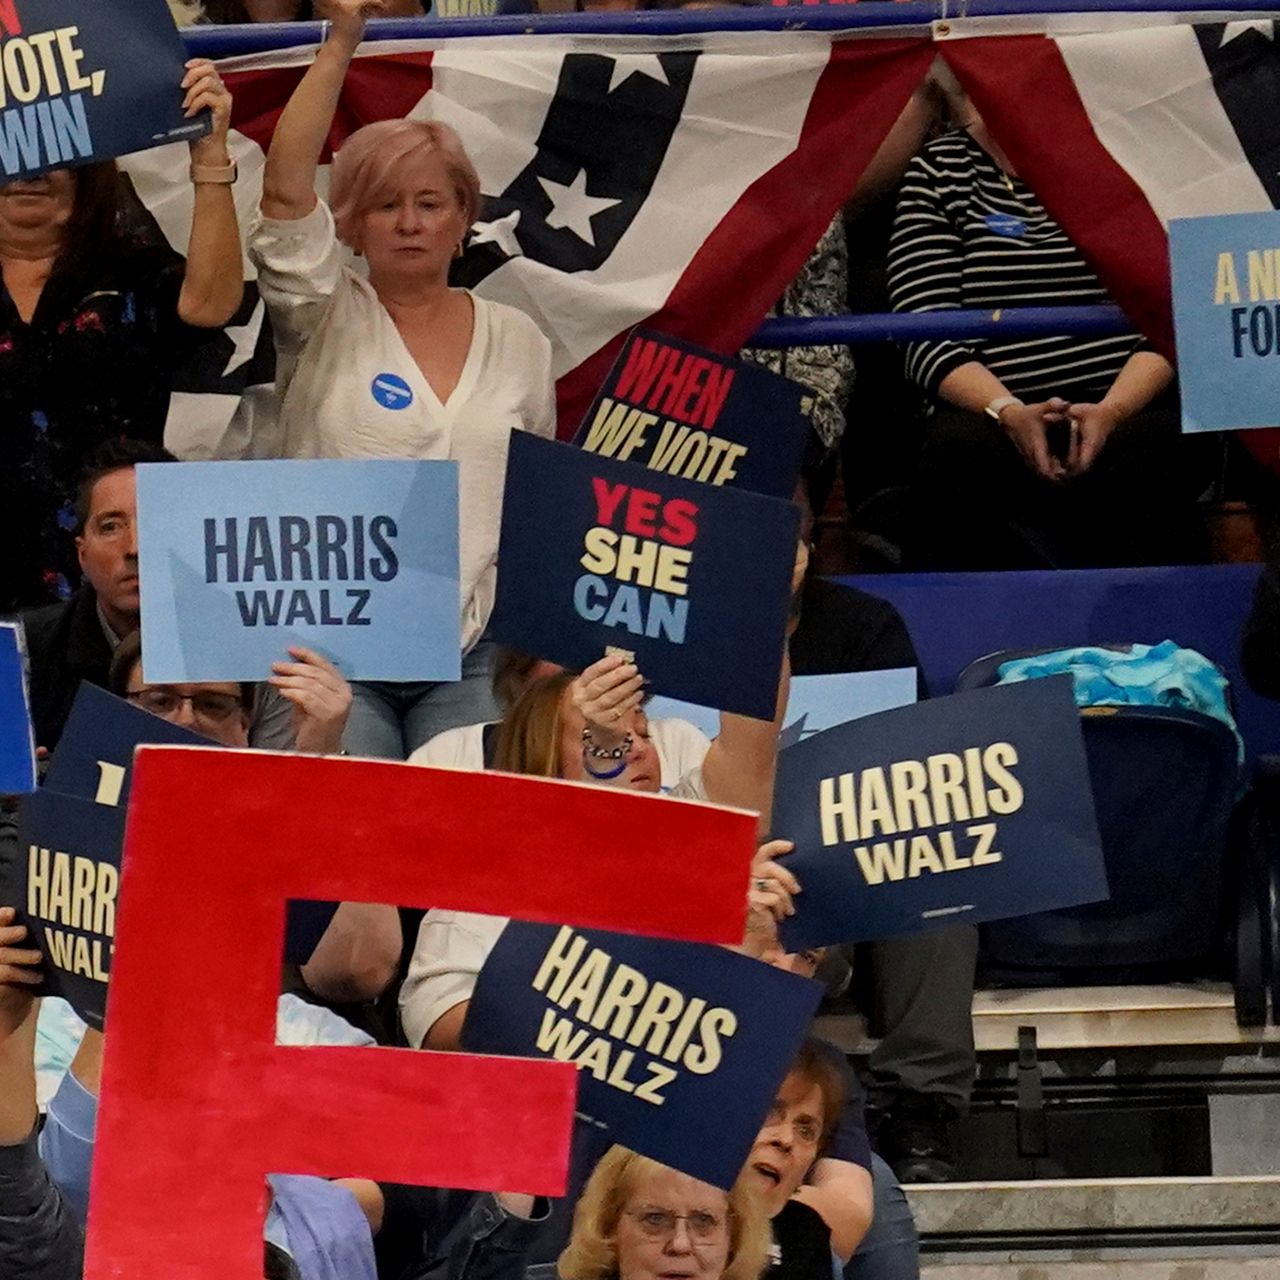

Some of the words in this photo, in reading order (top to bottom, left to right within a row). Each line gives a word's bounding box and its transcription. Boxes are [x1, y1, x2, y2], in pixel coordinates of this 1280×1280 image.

[1214, 252, 1241, 305] A
[613, 336, 735, 430] WHEN
[583, 397, 653, 463] WE
[591, 478, 699, 545] YES
[203, 514, 399, 583] HARRIS
[580, 527, 693, 595] SHE
[235, 589, 372, 628] WALZ
[572, 575, 688, 644] CAN
[818, 741, 1024, 846] HARRIS
[854, 823, 1003, 886] WALZ
[26, 846, 118, 934] HARR
[44, 928, 113, 983] WAL
[532, 926, 736, 1076] HARRIS
[536, 1009, 680, 1106] WALZ
